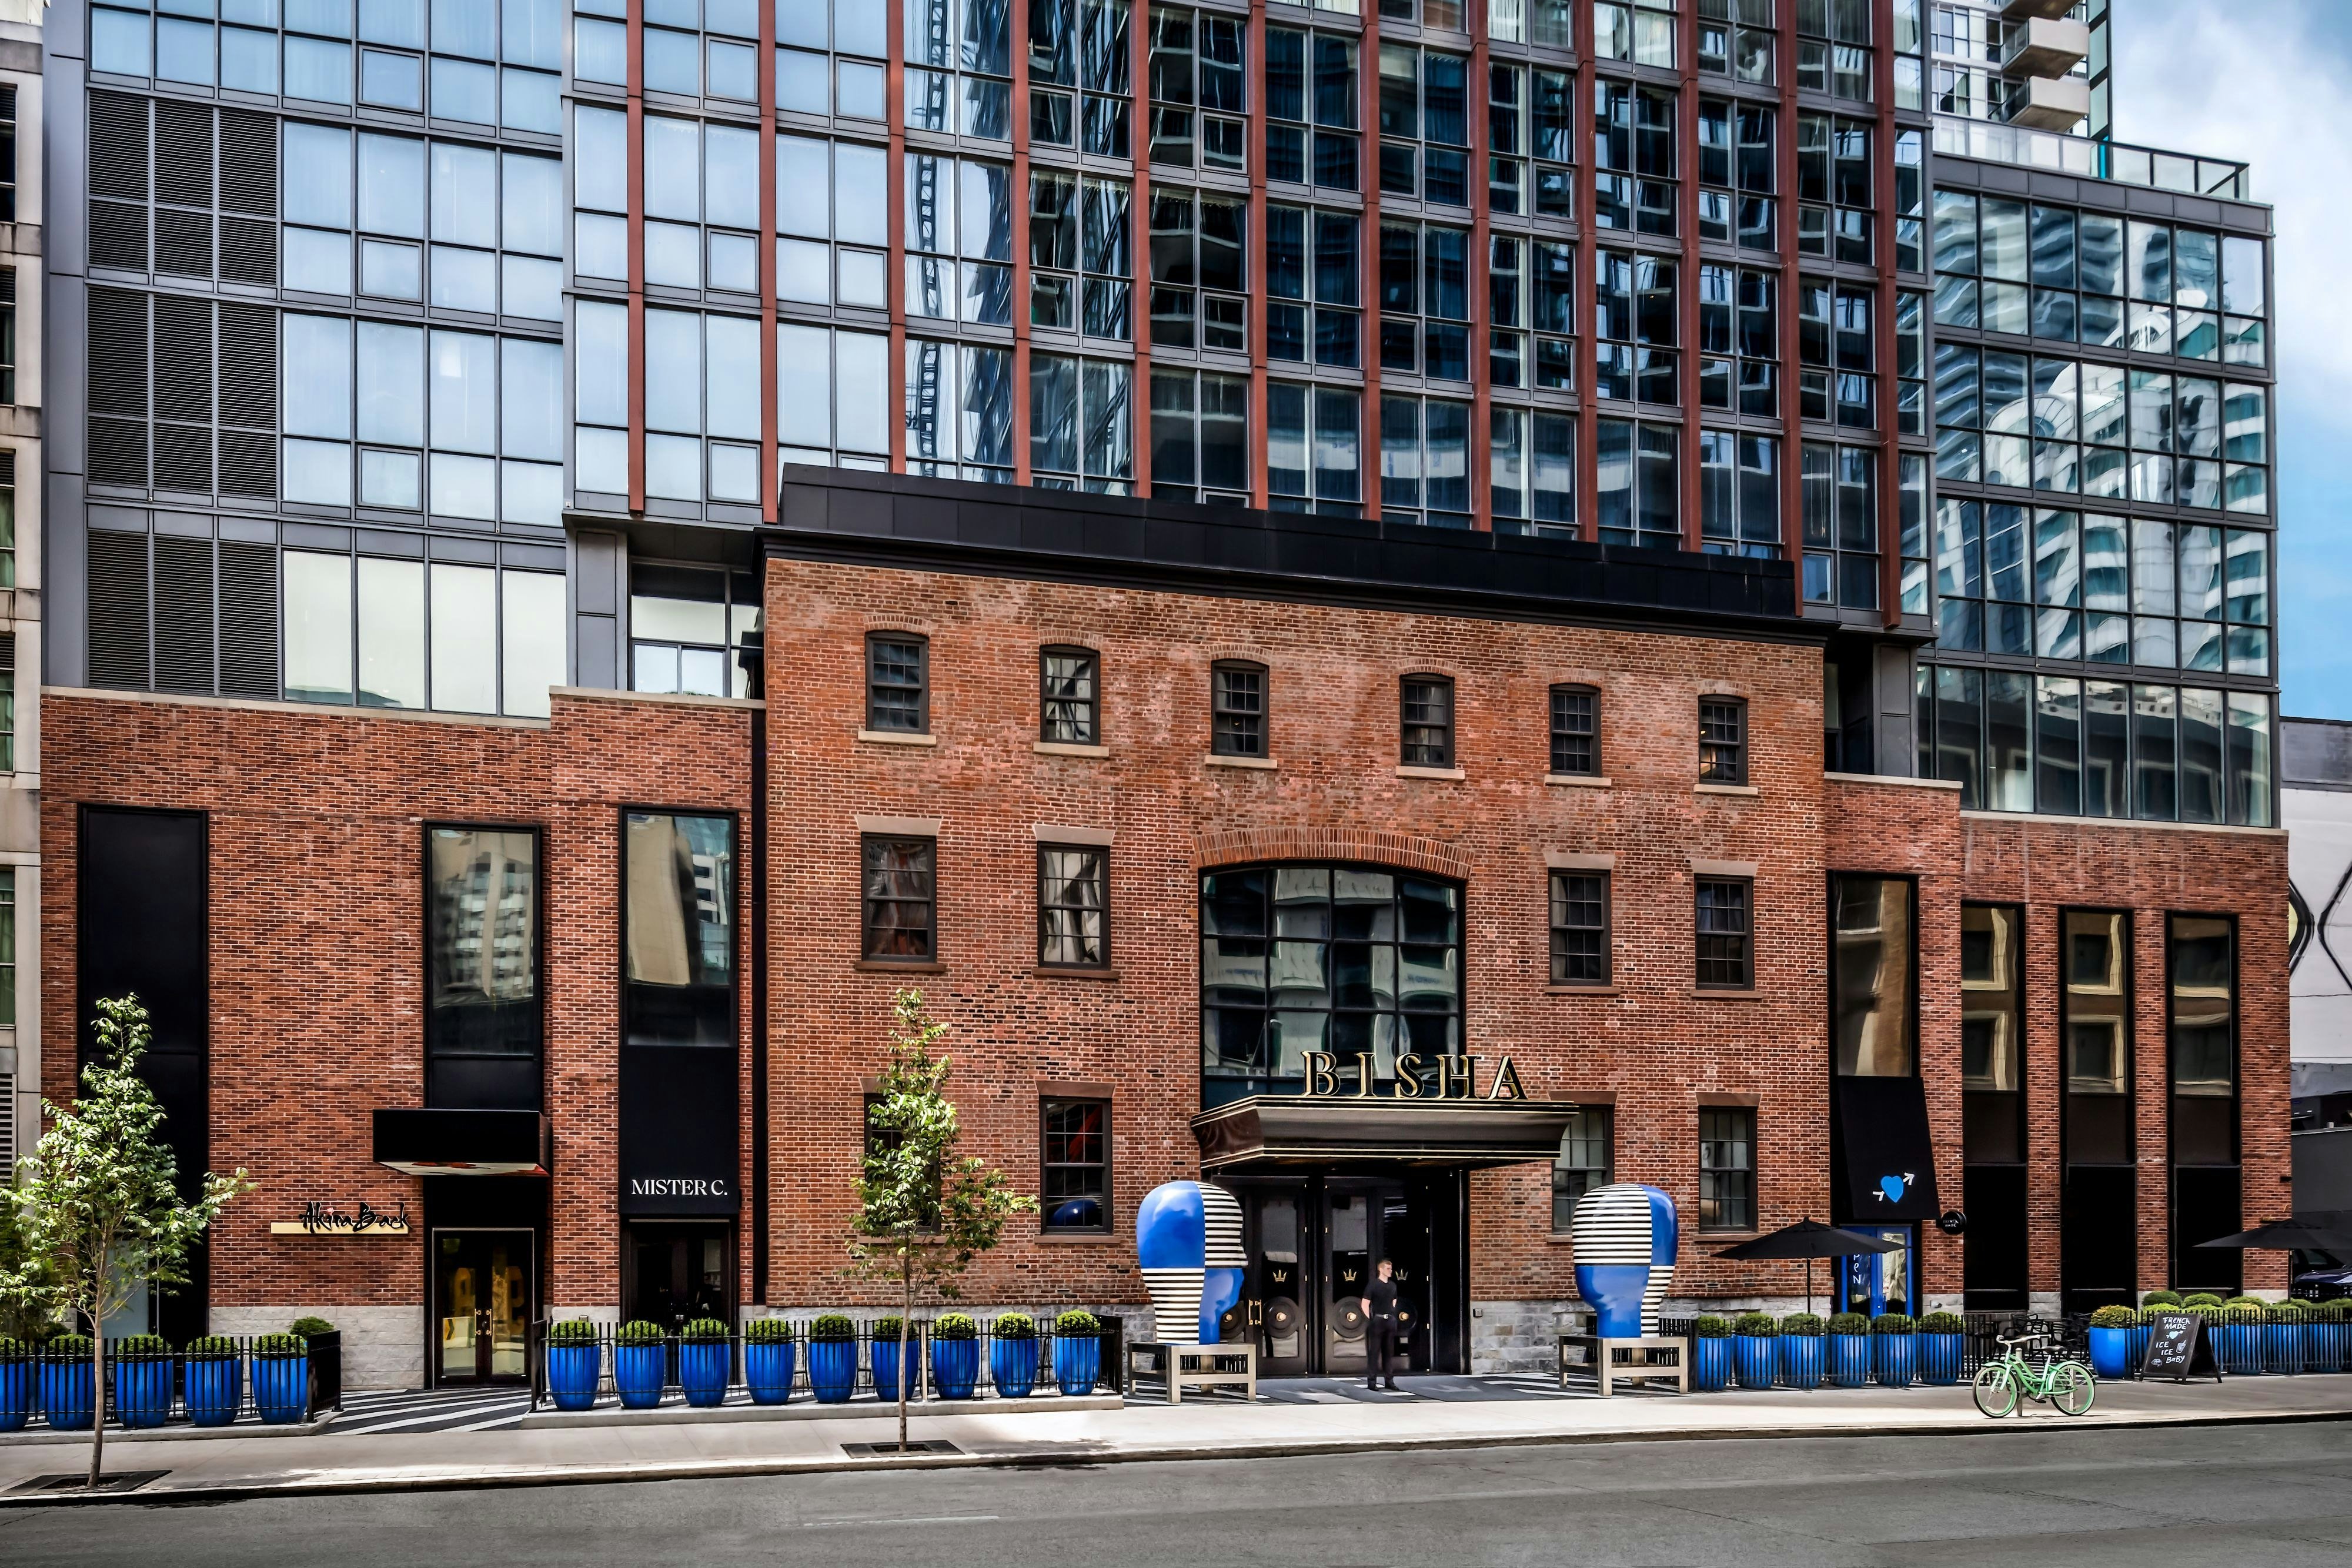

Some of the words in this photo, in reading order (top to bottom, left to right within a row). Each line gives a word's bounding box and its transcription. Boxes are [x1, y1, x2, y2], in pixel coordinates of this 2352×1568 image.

[1301, 1050, 1528, 1100] BISHA
[631, 1179, 707, 1195] MISTER
[711, 1179, 728, 1196] C.
[299, 1201, 354, 1233] Akira
[353, 1201, 413, 1232] Back
